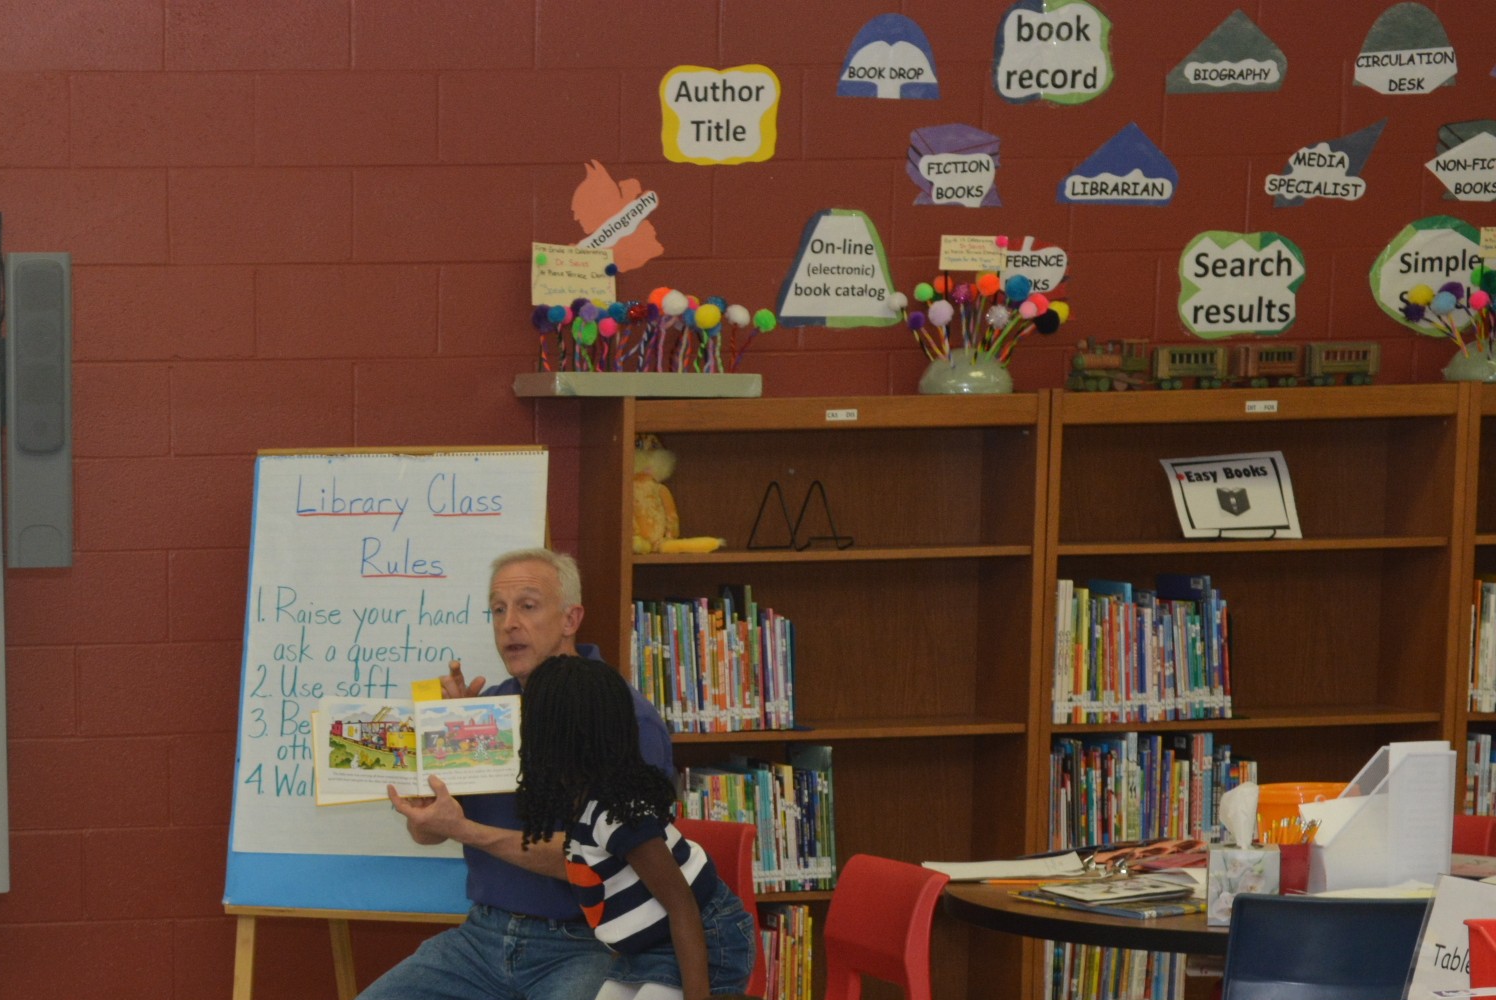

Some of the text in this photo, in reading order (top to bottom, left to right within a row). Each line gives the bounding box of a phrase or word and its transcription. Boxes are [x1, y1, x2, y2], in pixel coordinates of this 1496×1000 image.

[1017, 14, 1090, 42] book
[1356, 51, 1454, 68] CIRCULATION
[848, 66, 924, 81] BOOK DROP
[1006, 66, 1097, 90] record
[1193, 68, 1271, 81] BIOGRAPHY
[674, 79, 765, 102] Author
[1388, 78, 1425, 92] DESK
[691, 119, 747, 142] Title
[927, 160, 990, 175] FICTION
[1293, 152, 1346, 169] MEDIA
[1435, 157, 1496, 172] NON-FIC
[936, 184, 984, 200] BOOKS
[1071, 182, 1164, 197] LIBRARIAN
[1268, 179, 1362, 197] SPECIALIST
[810, 238, 874, 255] On-line
[807, 264, 875, 279] (electronic)
[1194, 250, 1293, 278] Search
[1399, 248, 1482, 277] Simple
[794, 281, 886, 301] book catalog
[1193, 296, 1291, 324] results
[1185, 464, 1268, 483] Easy Books
[296, 472, 502, 533] Library Class
[360, 536, 445, 576] Rules
[276, 586, 341, 624] Raise
[352, 605, 407, 643] your
[418, 589, 470, 626] hand
[273, 623, 461, 682] ask a question.
[280, 664, 324, 699] Use
[335, 664, 398, 699] soft
[277, 734, 312, 761] oth
[274, 764, 315, 797] Wal
